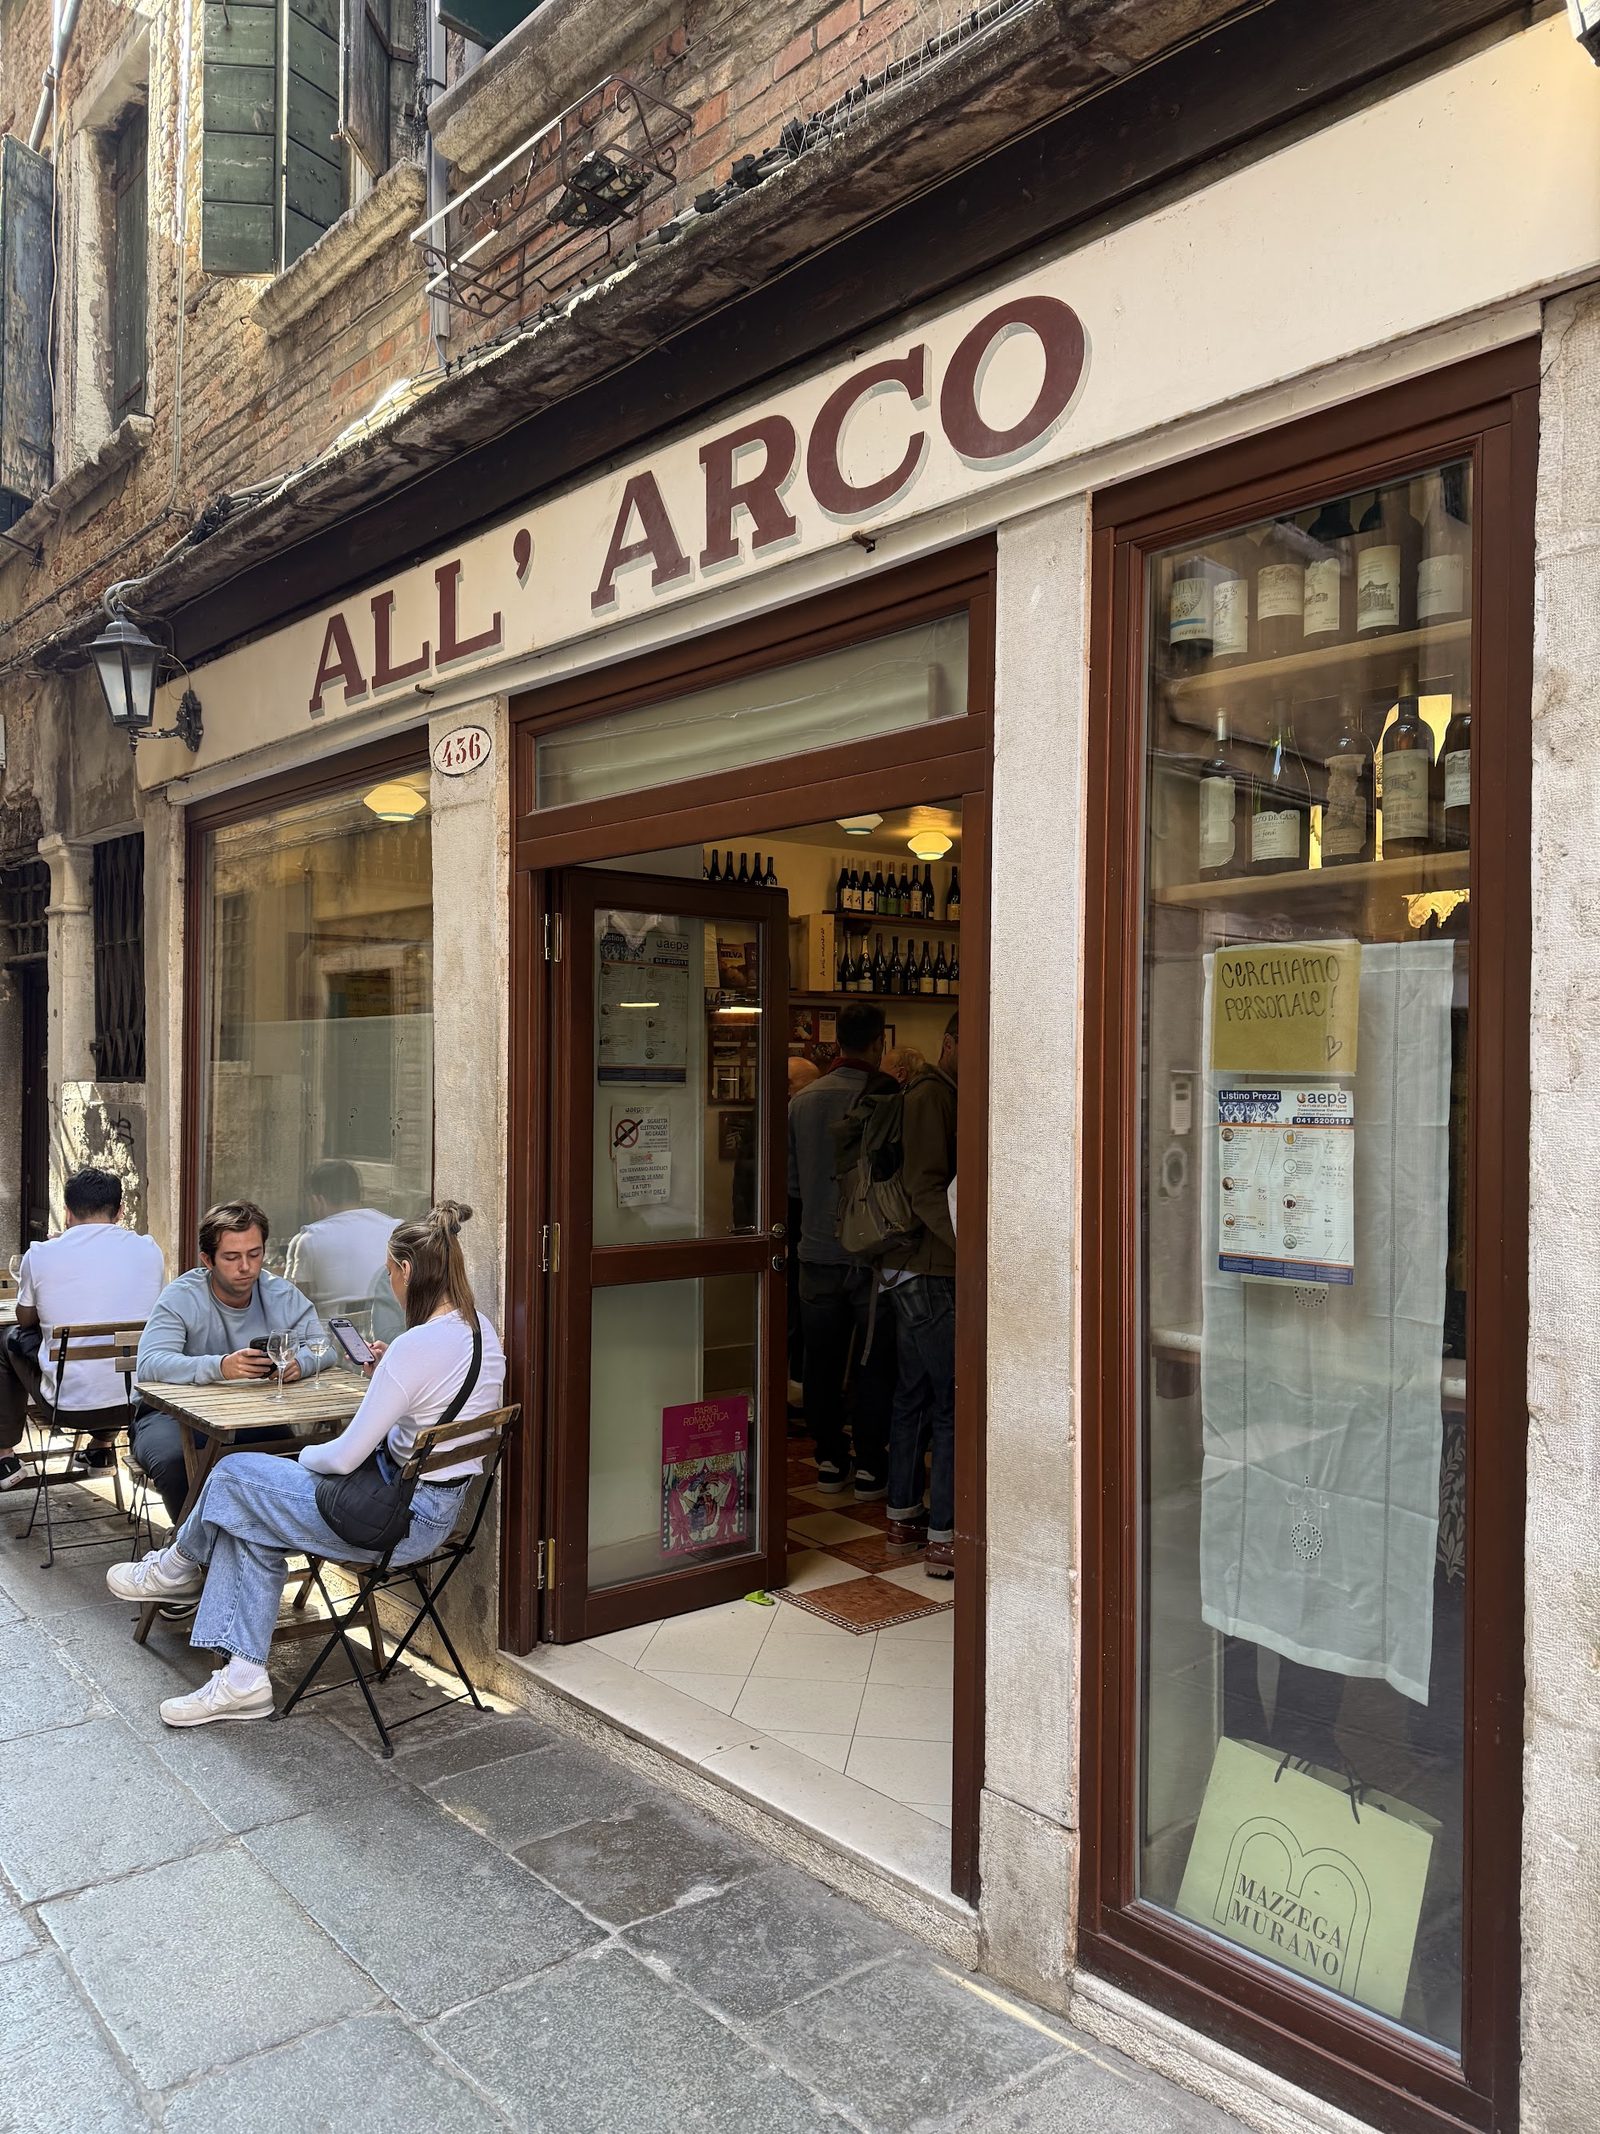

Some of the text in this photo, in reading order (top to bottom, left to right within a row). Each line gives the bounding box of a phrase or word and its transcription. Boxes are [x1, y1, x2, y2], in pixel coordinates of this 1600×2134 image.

[590, 295, 1092, 617] ARCO
[441, 732, 481, 768] 436
[1221, 1091, 1280, 1100] Listino Prezzi
[683, 1411, 730, 1427] ROMANTICA
[694, 1404, 719, 1416] PARIGI
[1235, 1872, 1342, 1950] MAZZEGA
[1229, 1899, 1339, 1977] MURANO
